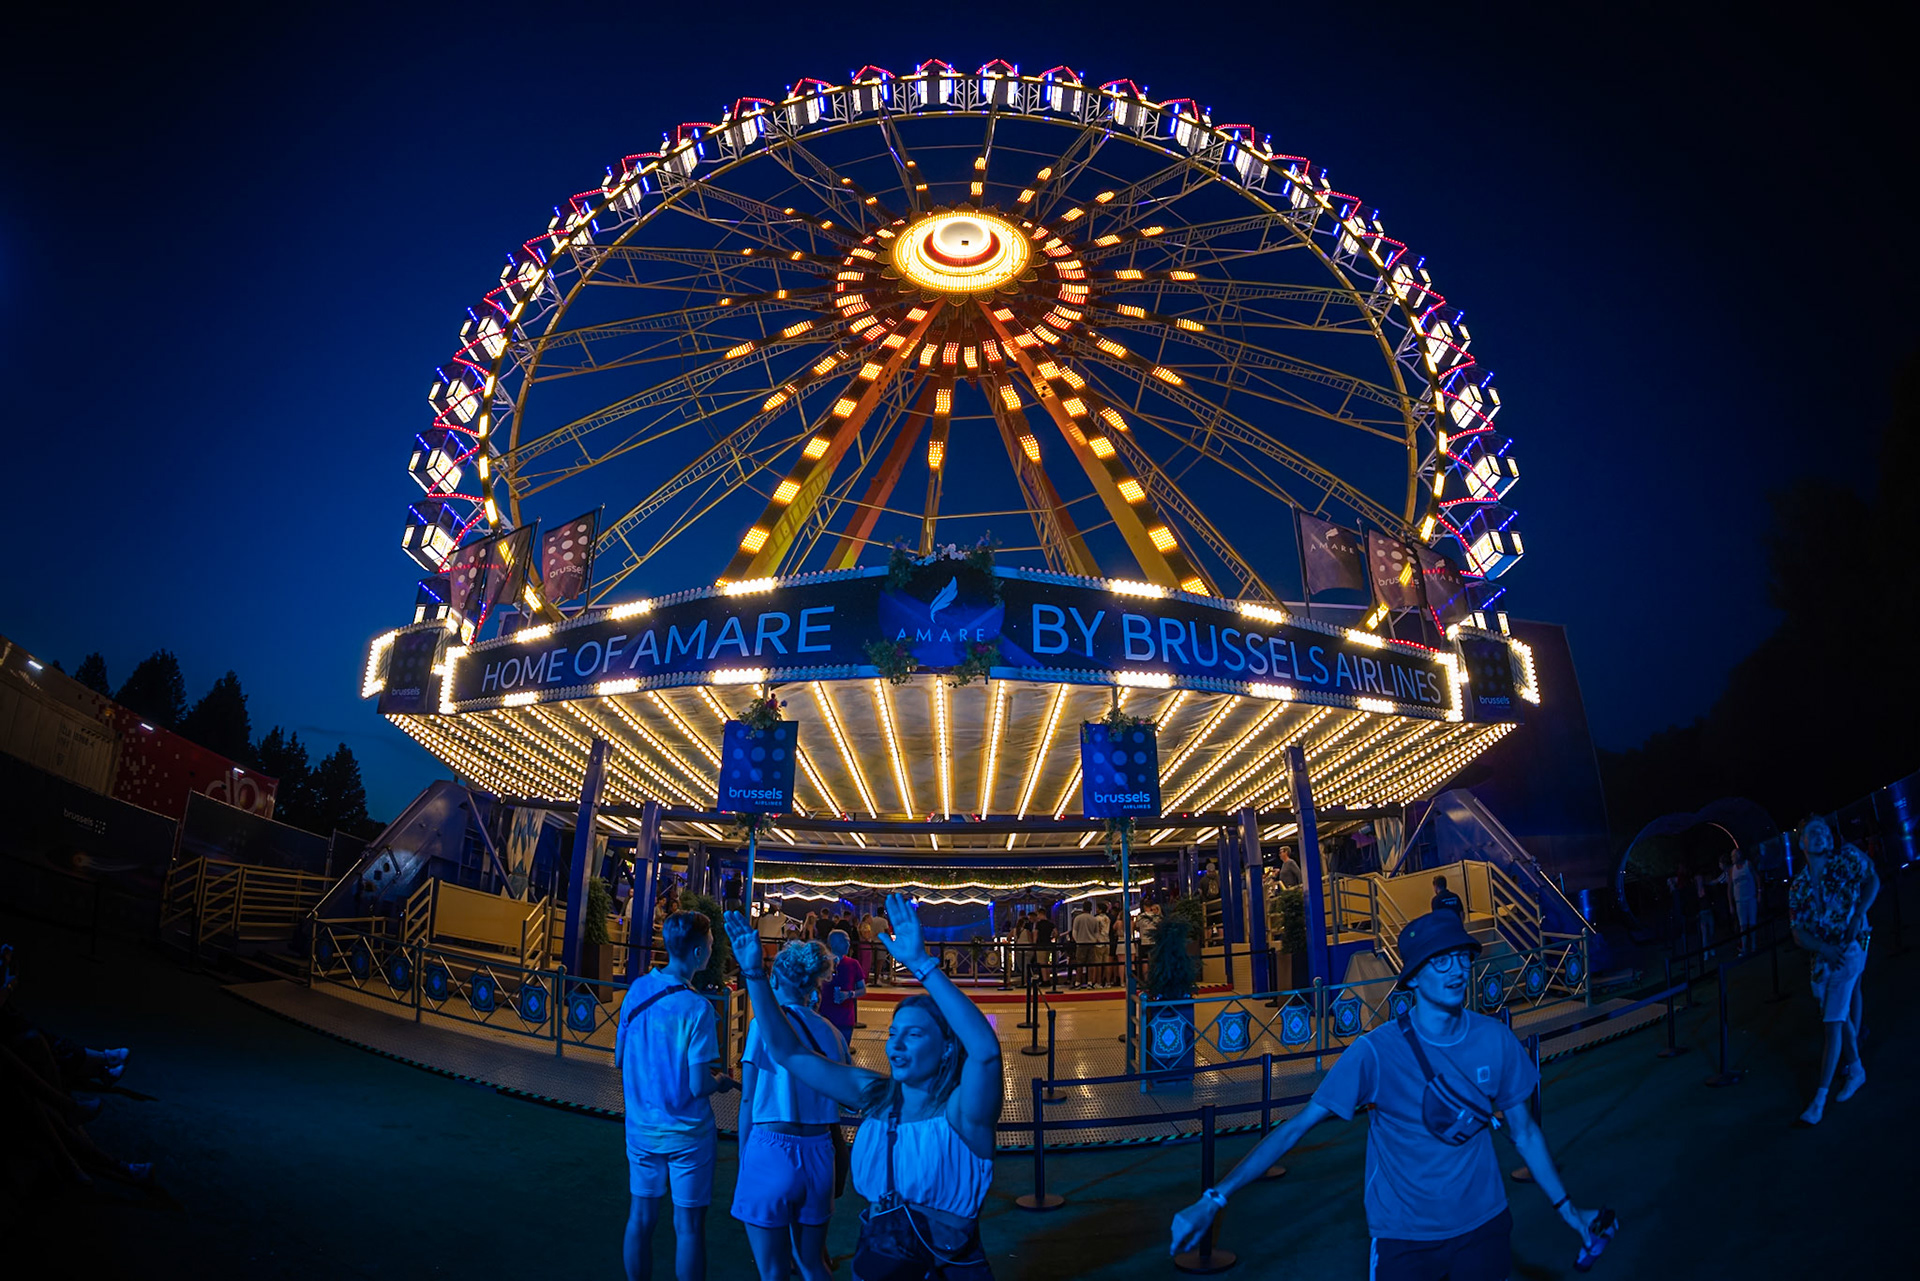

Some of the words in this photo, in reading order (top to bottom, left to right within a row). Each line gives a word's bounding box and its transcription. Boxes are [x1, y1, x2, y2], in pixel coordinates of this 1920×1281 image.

[1377, 575, 1420, 587] brusls
[896, 628, 985, 642] AMARE
[481, 648, 568, 692] HOME
[574, 634, 628, 677] OF
[629, 606, 835, 669] AMARE
[1032, 603, 1106, 657] BY
[1122, 613, 1330, 685] BRUSSELS
[1336, 652, 1442, 704] AIRLINES
[391, 686, 420, 696] brussels
[1479, 695, 1511, 705] brussels
[728, 786, 783, 800] brussels
[1094, 790, 1151, 804] brussels
